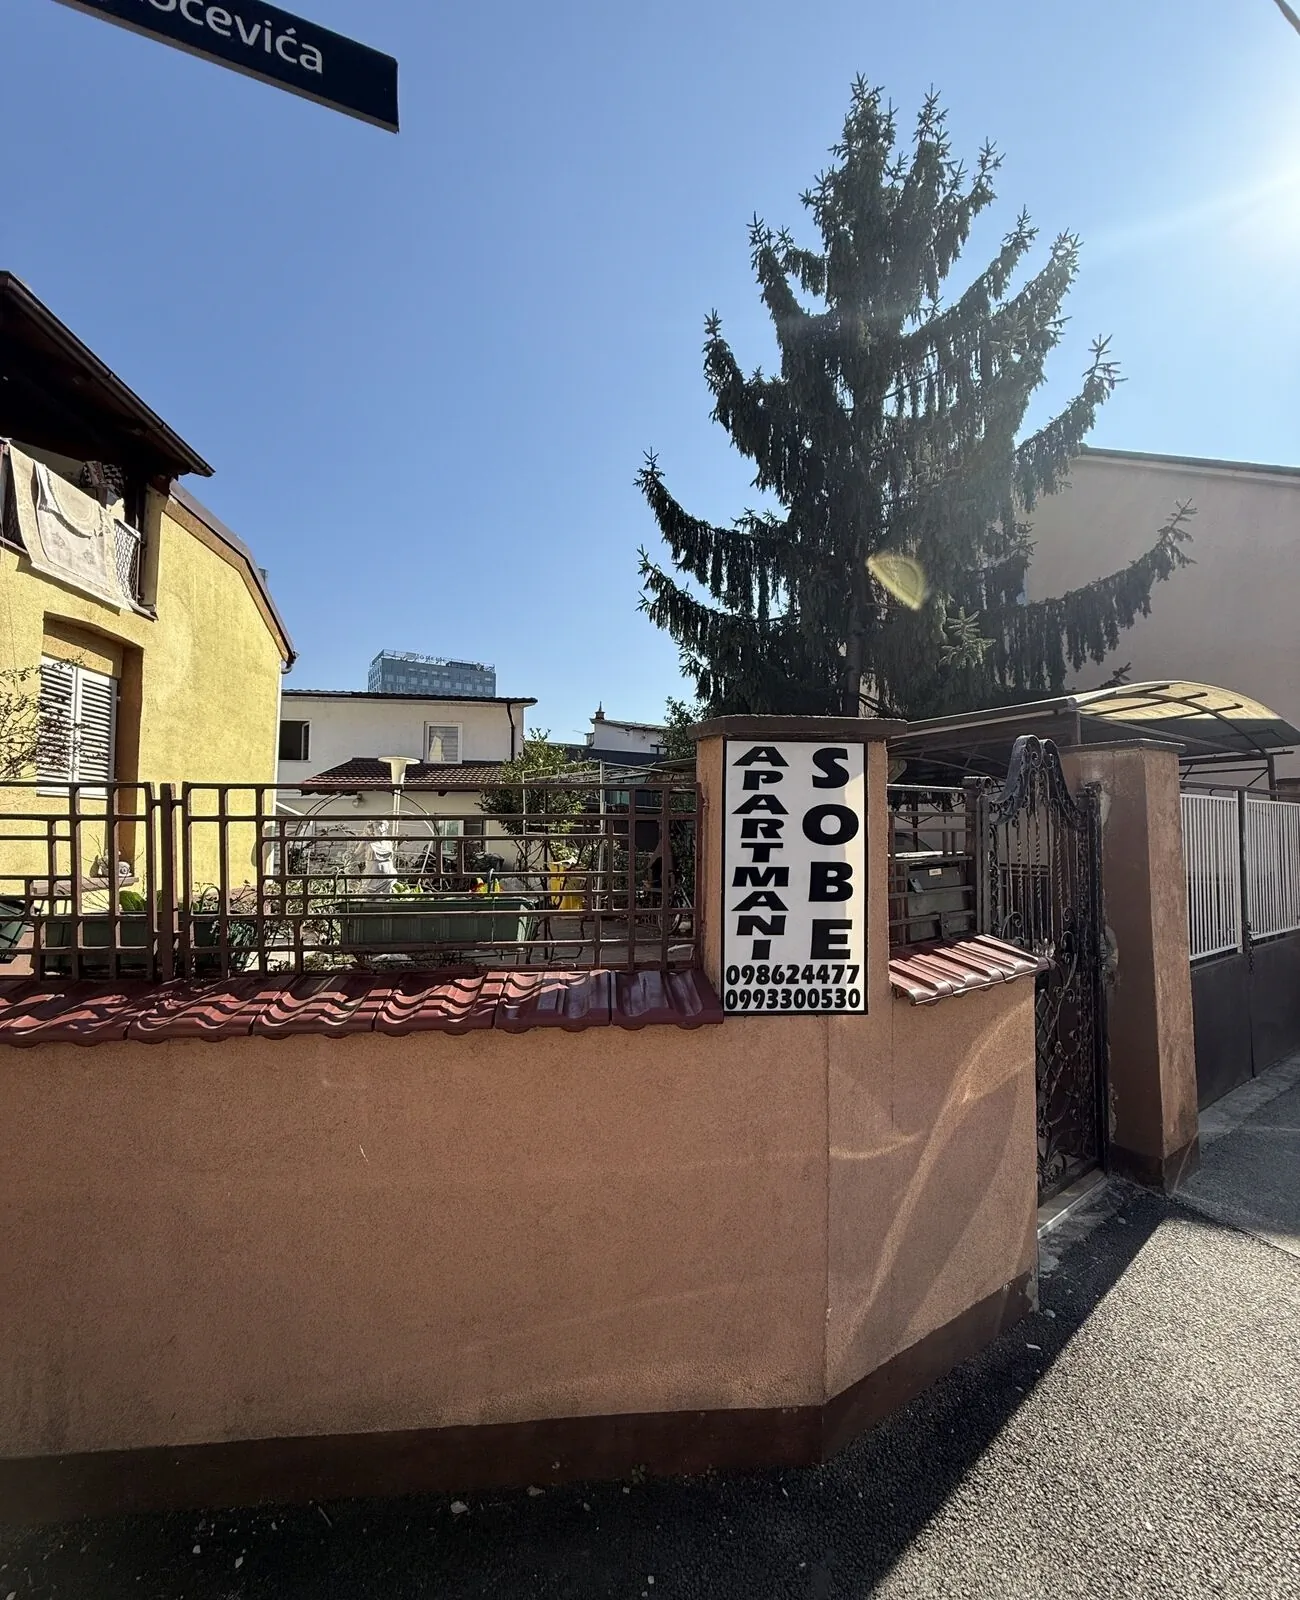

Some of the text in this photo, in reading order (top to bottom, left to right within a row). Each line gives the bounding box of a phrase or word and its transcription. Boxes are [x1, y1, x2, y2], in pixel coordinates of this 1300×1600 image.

[731, 745, 790, 961] APARTMANI
[802, 747, 860, 960] SOBE
[725, 964, 860, 986] 098624477
[725, 987, 861, 1010] 0993300530
